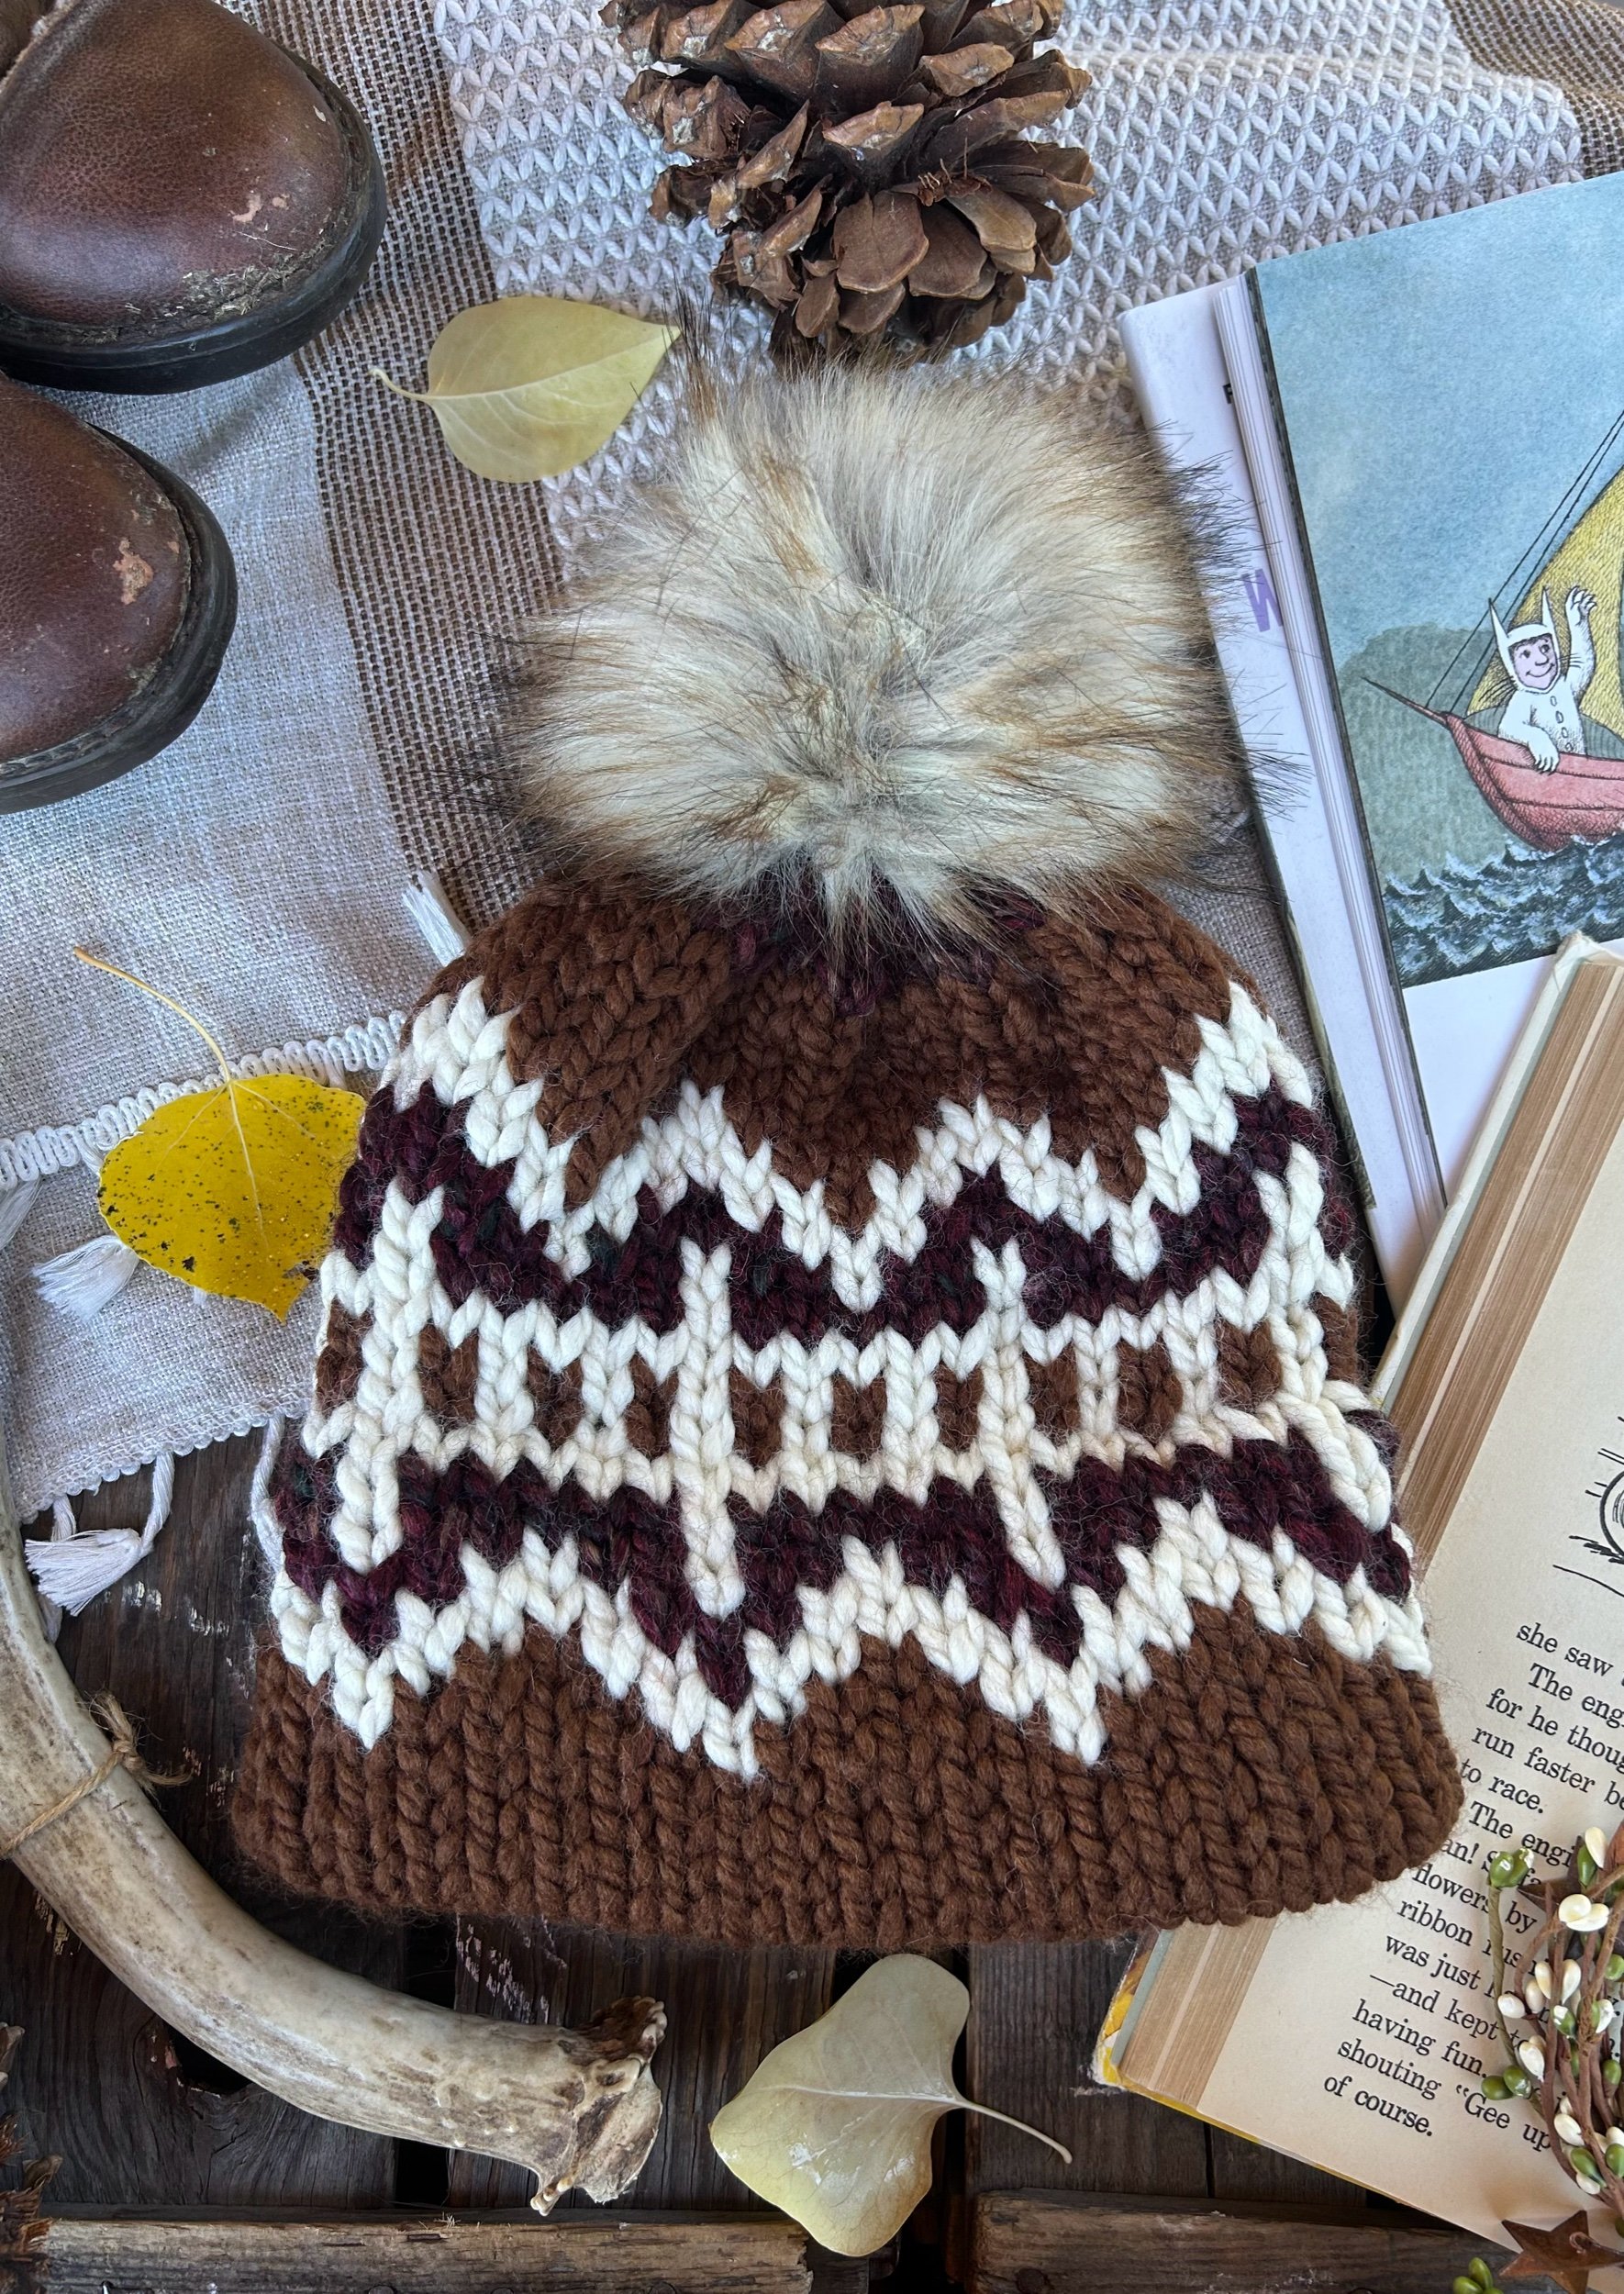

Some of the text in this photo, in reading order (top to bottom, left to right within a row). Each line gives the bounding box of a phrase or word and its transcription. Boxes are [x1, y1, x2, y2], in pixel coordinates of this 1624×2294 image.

[1516, 1622, 1558, 1653] she
[1564, 1646, 1614, 1676] saw
[1485, 1687, 1523, 1719] for
[1527, 1704, 1558, 1736] he
[1528, 1663, 1624, 1729] The eng
[1460, 1758, 1543, 1814] to race.
[1471, 1727, 1515, 1759] run
[1524, 1746, 1596, 1793] faster
[1468, 1800, 1513, 1839] The
[1396, 1899, 1474, 1946] ribbon
[1505, 1900, 1538, 1934] by
[1385, 1935, 1429, 1967] was
[1429, 1953, 1482, 1990] just
[1352, 1998, 1437, 2056] having
[1440, 2040, 1487, 2078] fun.
[1444, 1998, 1499, 2040] kept
[1337, 2038, 1441, 2100] shouting
[1324, 2075, 1433, 2137] of course.
